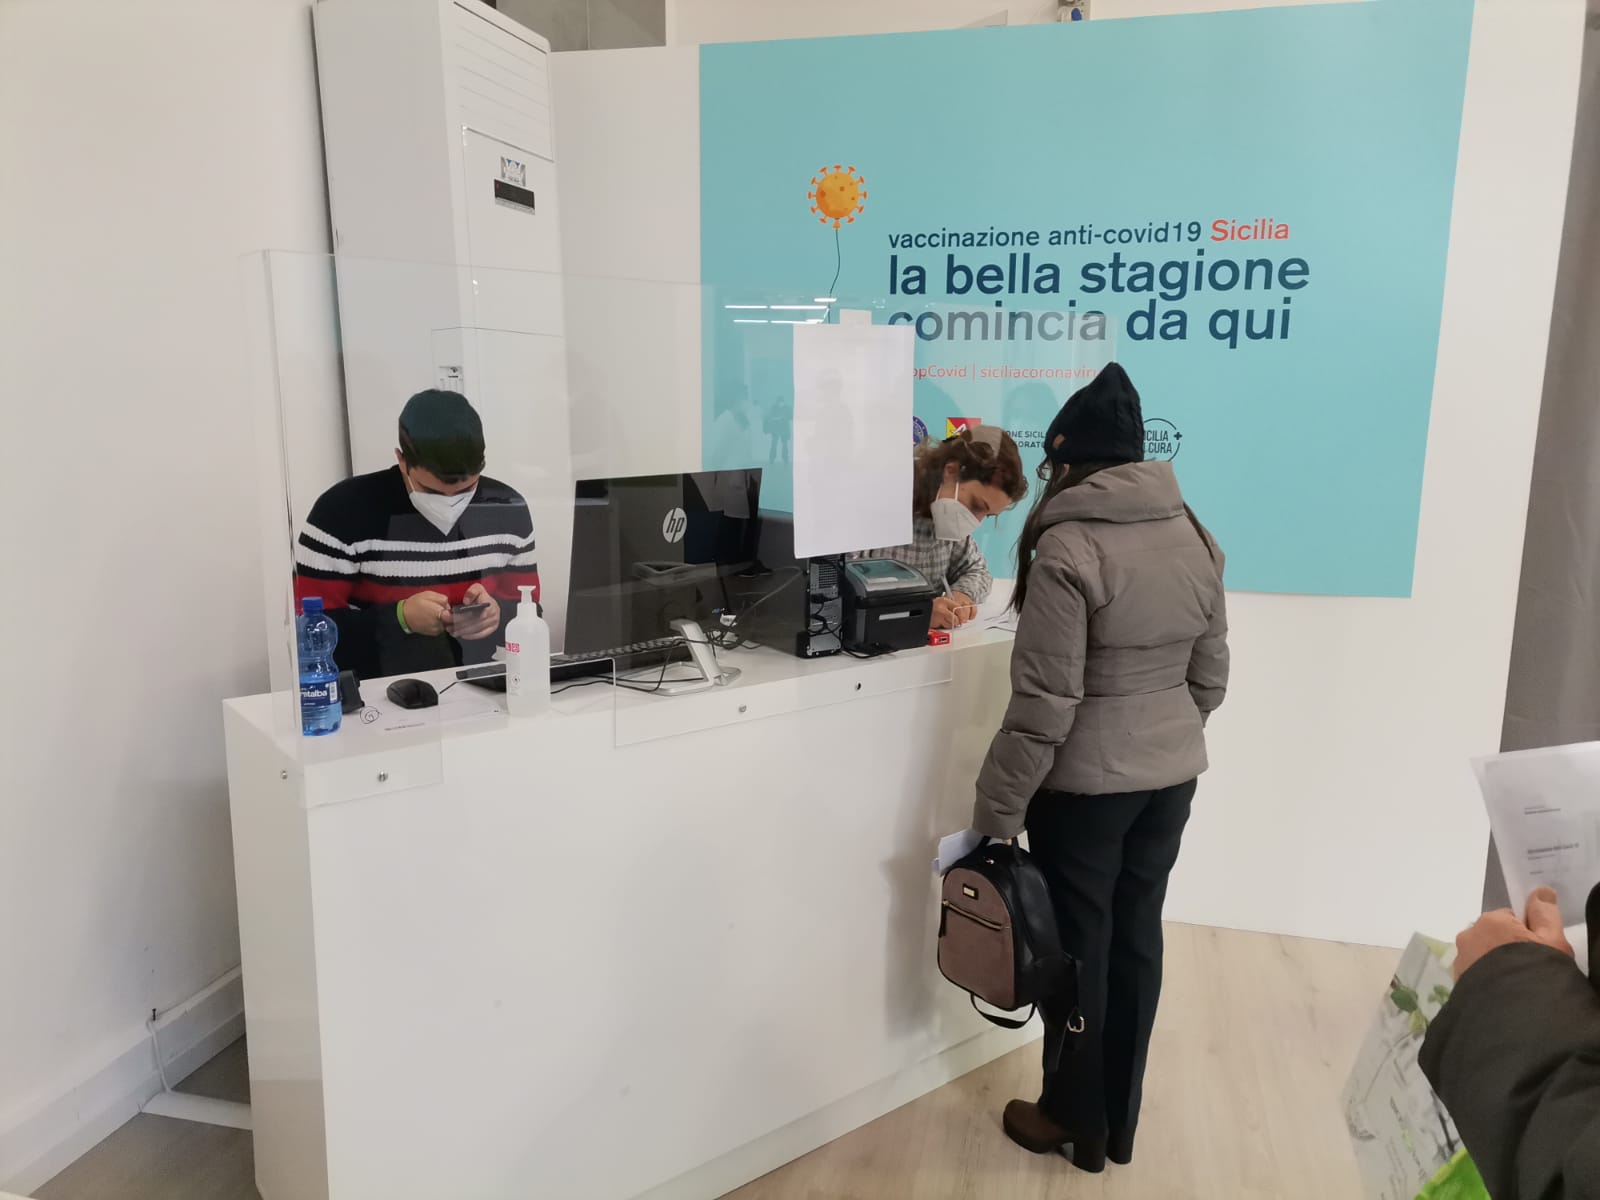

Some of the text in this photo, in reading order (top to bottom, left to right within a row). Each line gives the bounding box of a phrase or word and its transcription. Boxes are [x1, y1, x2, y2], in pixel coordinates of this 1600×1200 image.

[888, 218, 1290, 249] vaccinazione anti-covid19 Sicilia
[889, 248, 1310, 301] la bella stagione
[1126, 298, 1188, 341] da
[1208, 297, 1292, 349] qui
[913, 364, 967, 380] opCovid
[1148, 442, 1173, 454] CURA
[665, 507, 686, 544] hp
